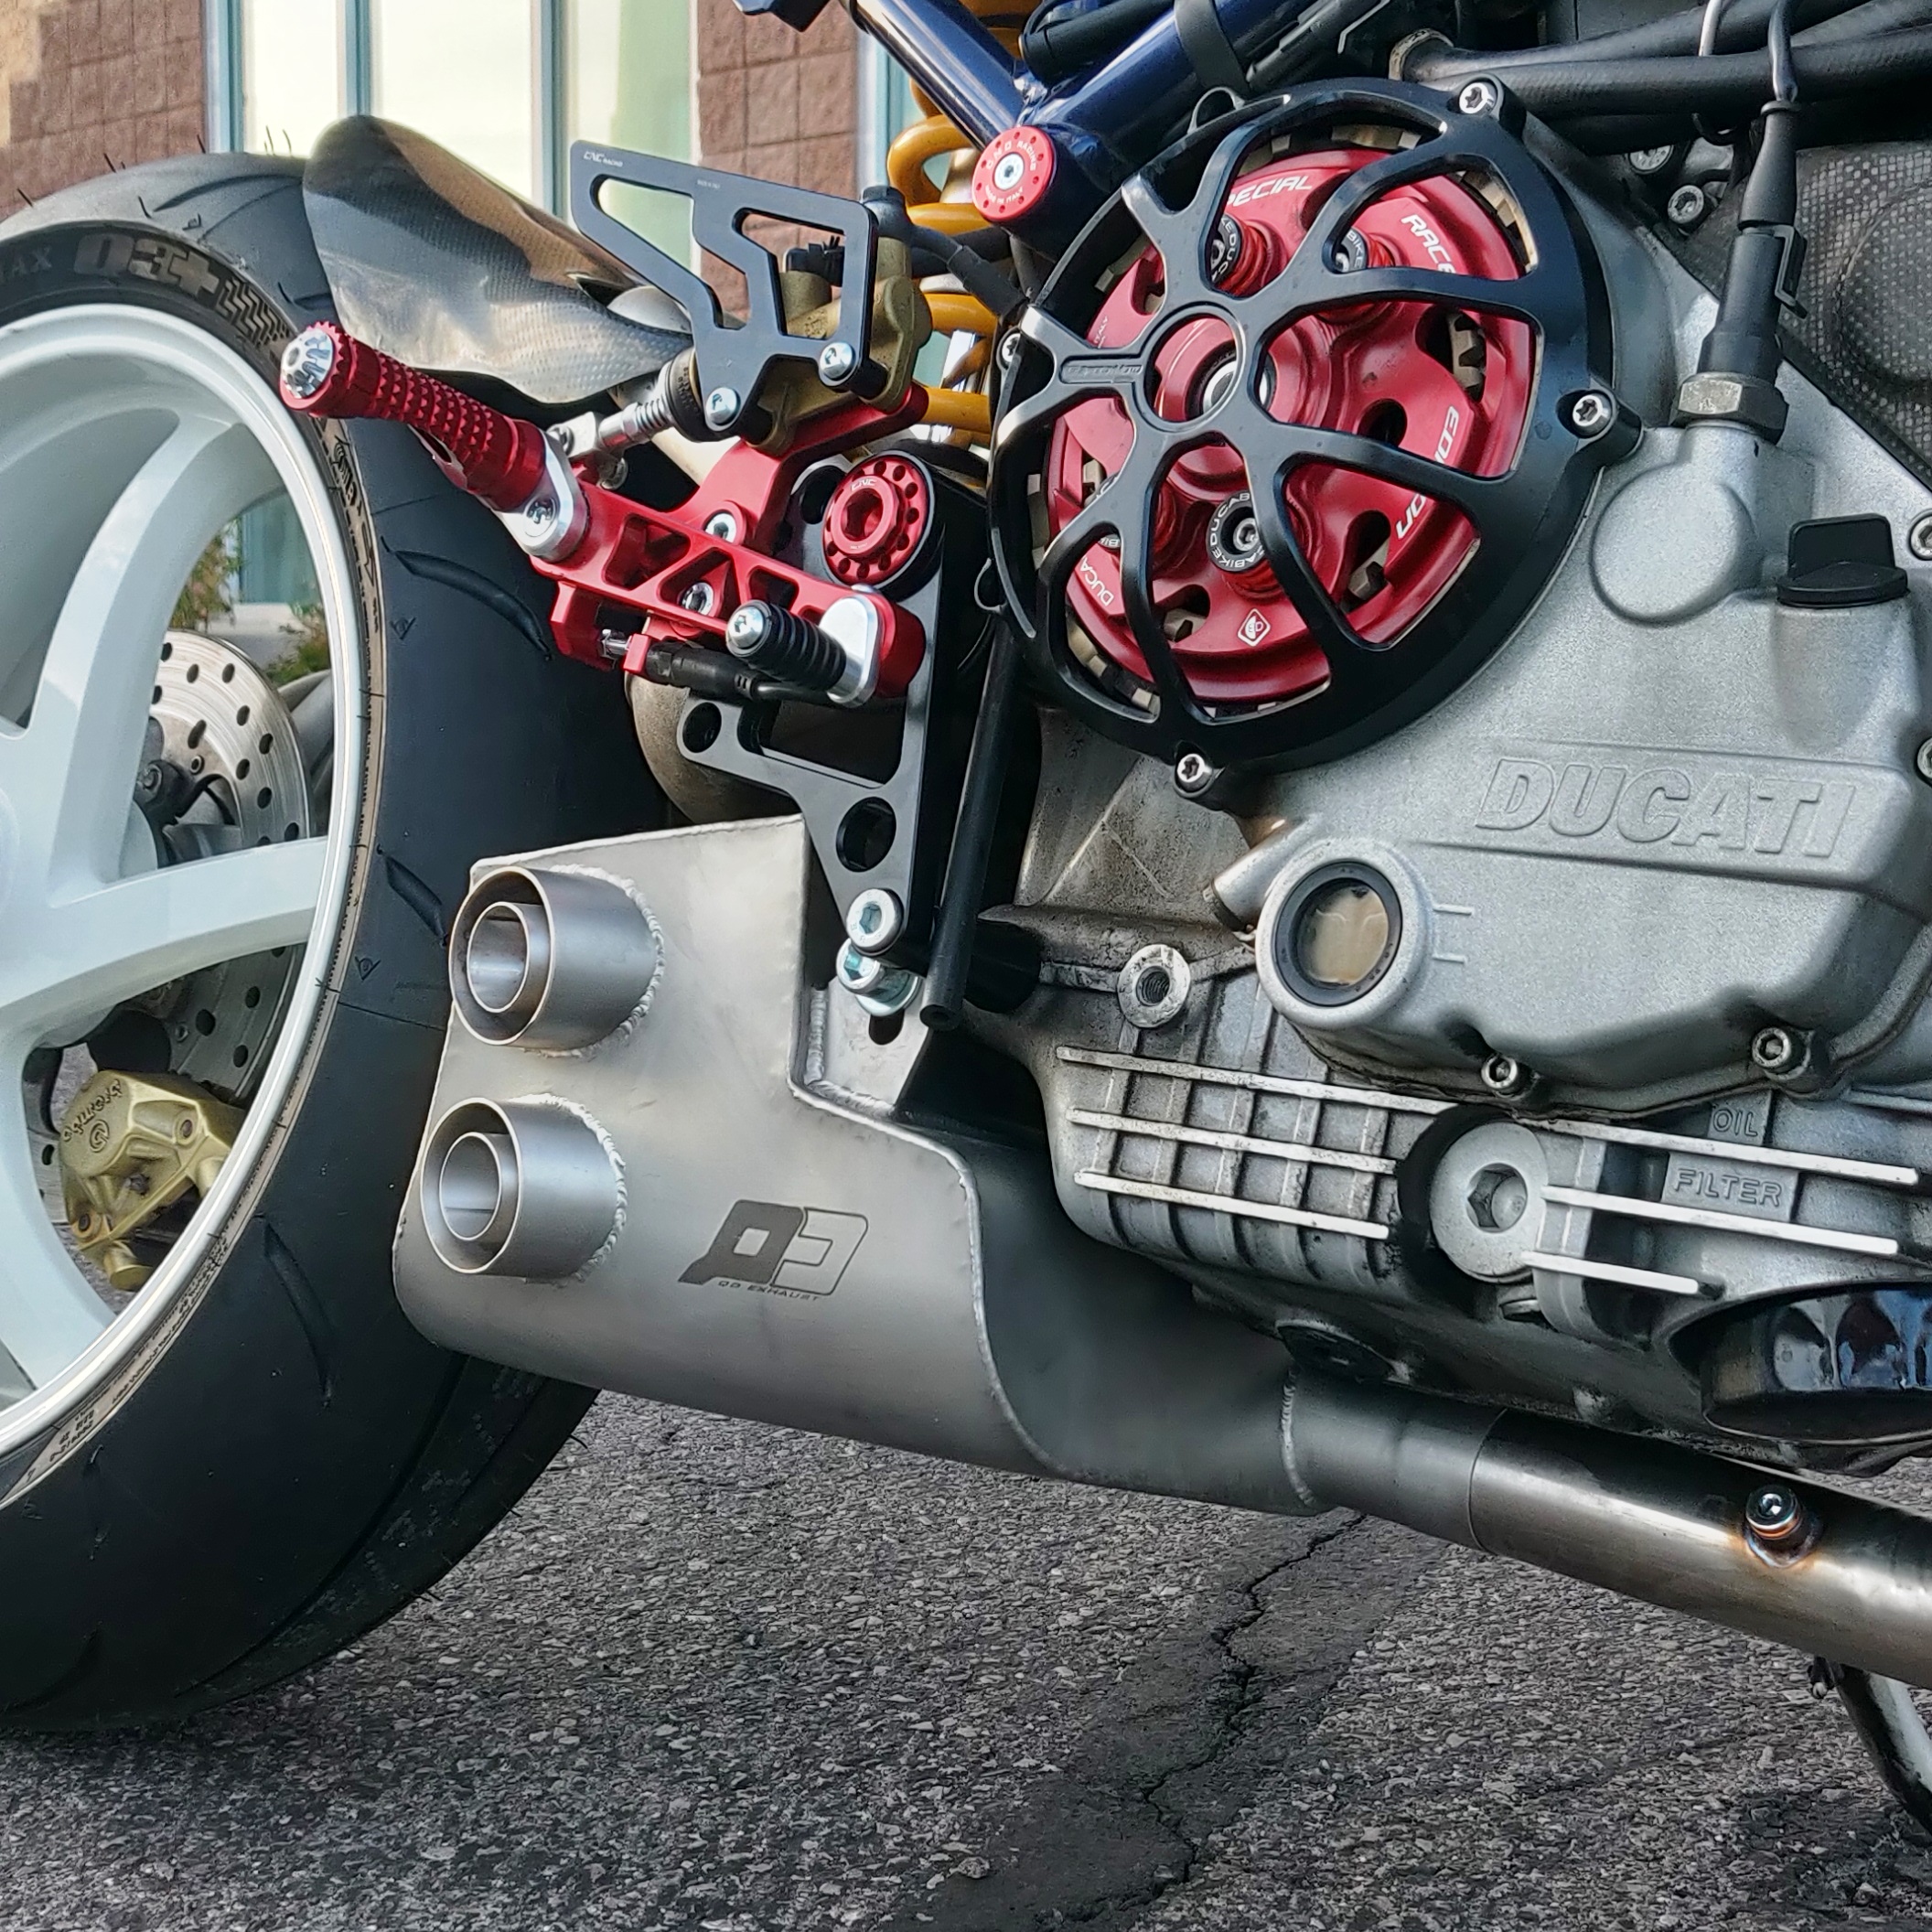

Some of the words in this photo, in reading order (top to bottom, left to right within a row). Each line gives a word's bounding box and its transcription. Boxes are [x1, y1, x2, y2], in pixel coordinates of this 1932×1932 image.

[1226, 175, 1313, 208] PECIAL
[1079, 555, 1115, 607] DUCA
[1475, 757, 1856, 858] DUCATI
[1712, 1107, 1759, 1137] OIL
[1674, 1167, 1783, 1208] FILTER
